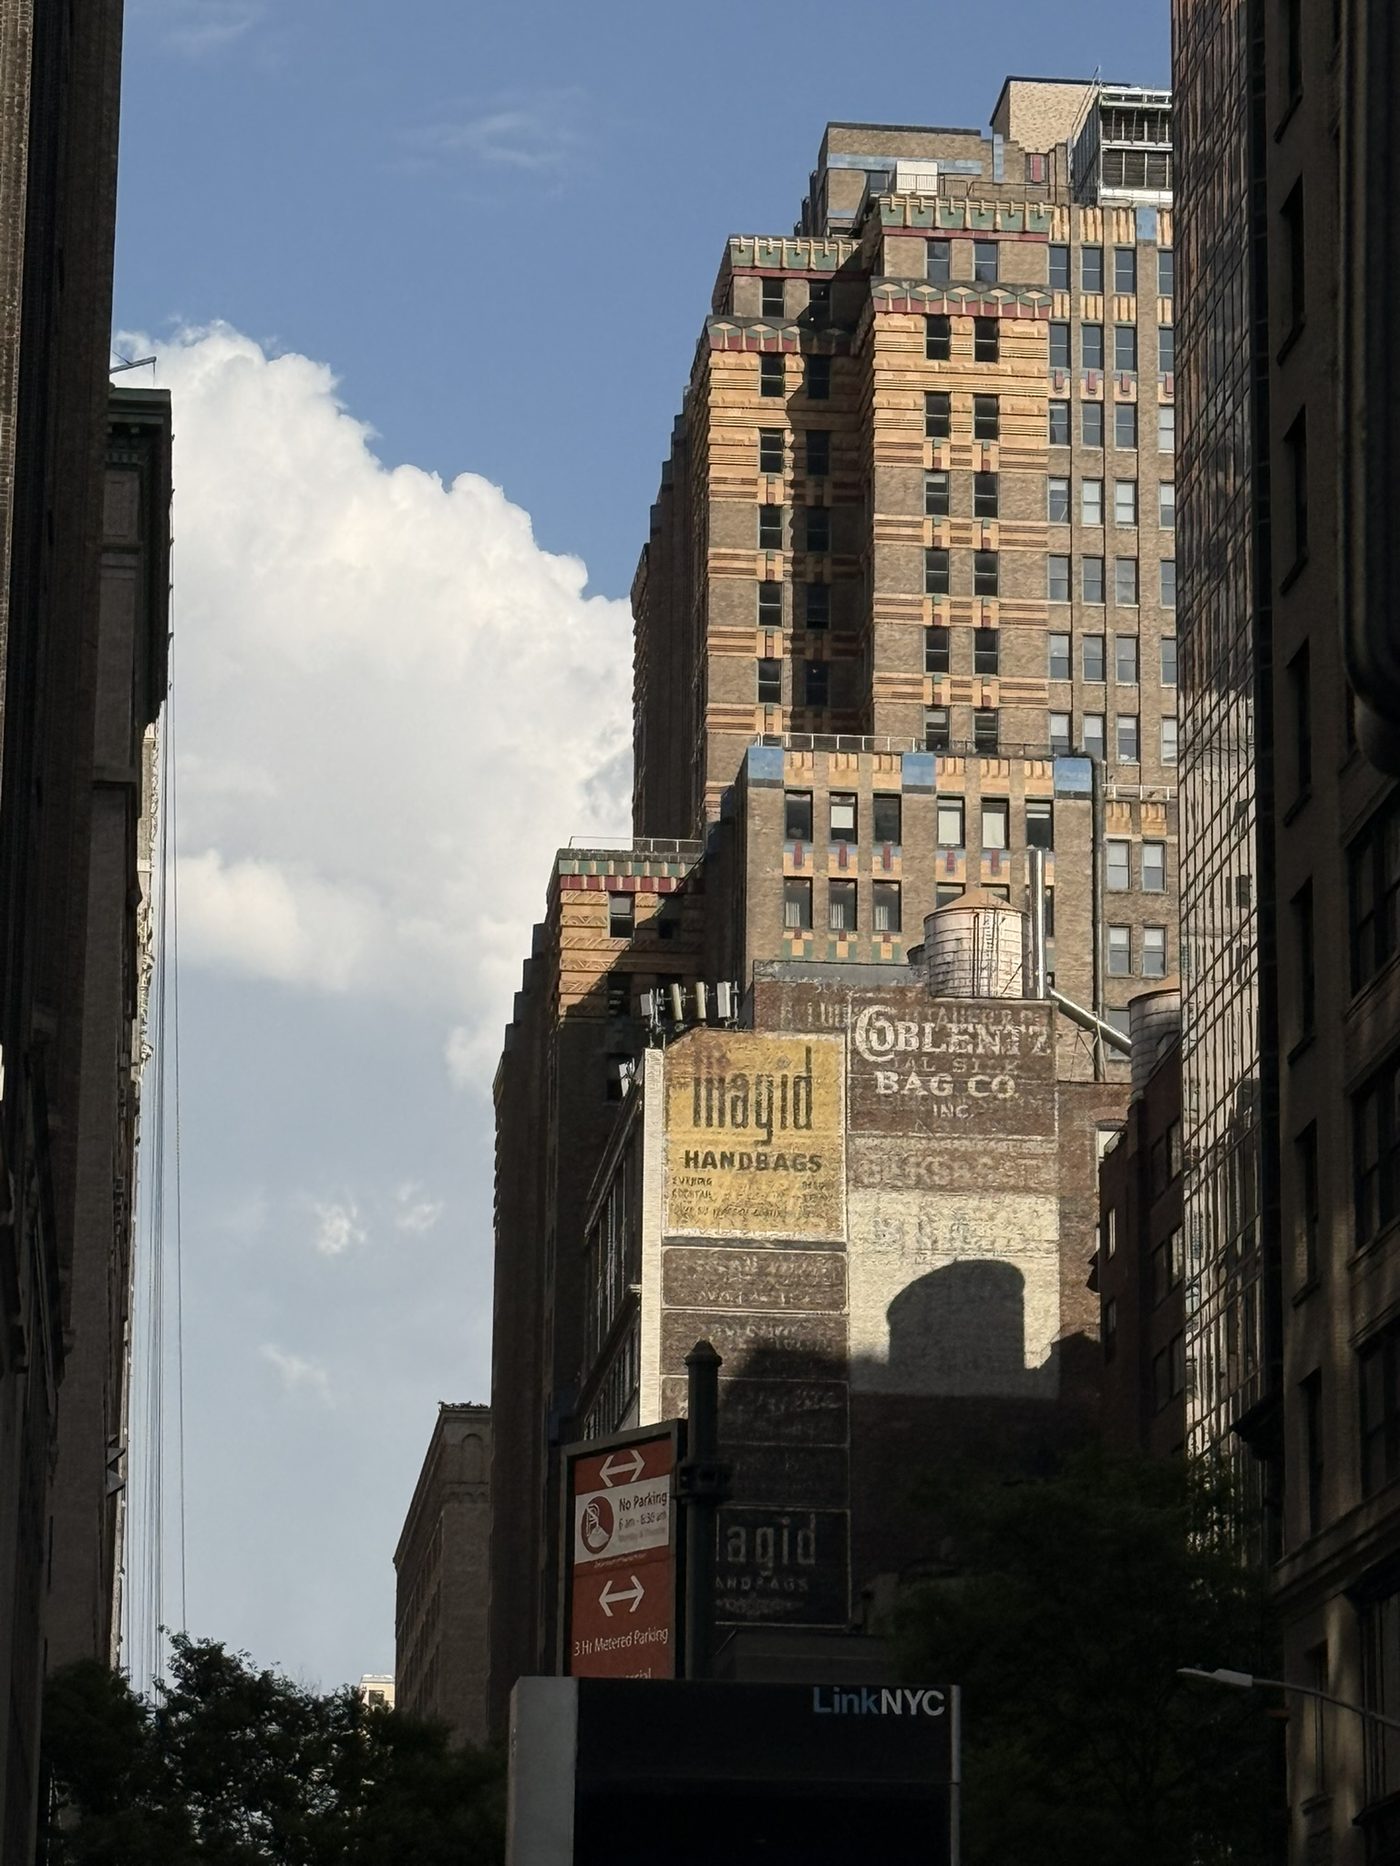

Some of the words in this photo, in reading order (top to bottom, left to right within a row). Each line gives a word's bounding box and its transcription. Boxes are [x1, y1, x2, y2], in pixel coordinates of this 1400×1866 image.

[855, 1004, 1051, 1062] COBLENTZ
[692, 1046, 813, 1147] magid
[873, 1071, 954, 1098] BAG
[684, 1149, 823, 1174] HANDBAGS
[619, 1498, 632, 1513] No
[633, 1491, 668, 1509] Parking
[715, 1512, 816, 1577] agid
[574, 1641, 580, 1656] 3
[582, 1640, 592, 1654] Hr
[594, 1632, 632, 1652] Metered
[633, 1626, 669, 1644] Parking
[813, 1686, 945, 1716] LinkNYC
